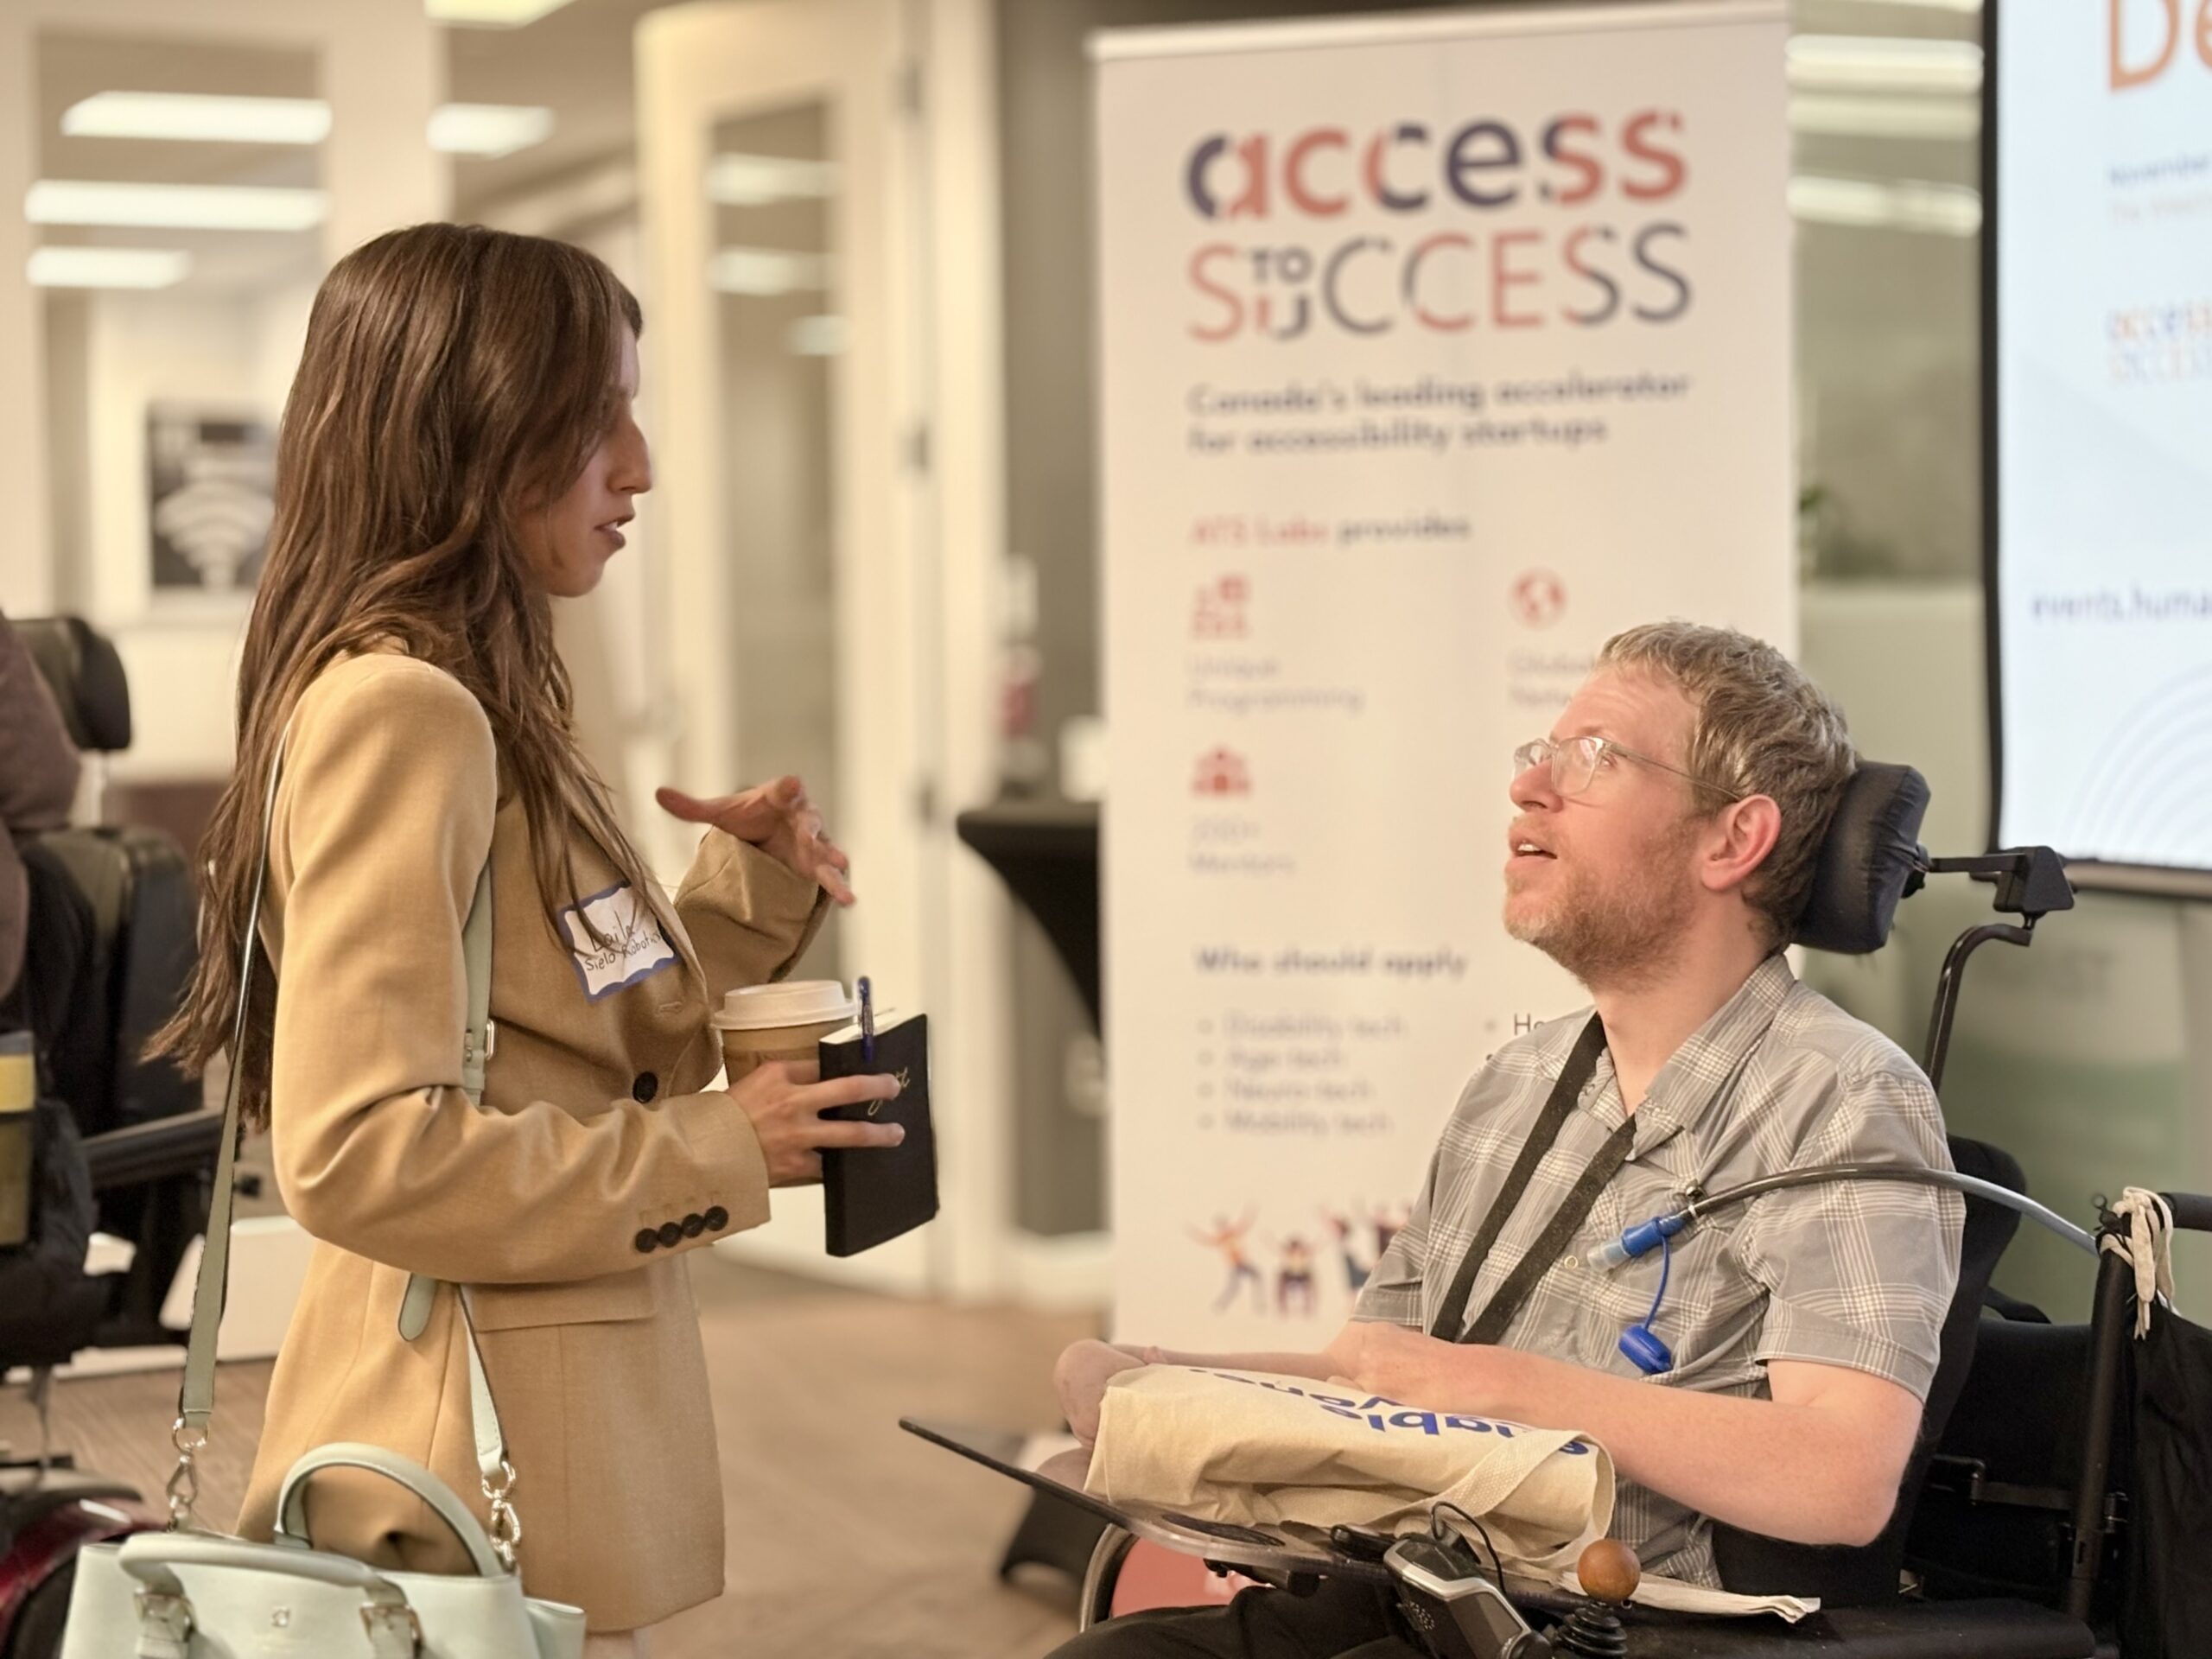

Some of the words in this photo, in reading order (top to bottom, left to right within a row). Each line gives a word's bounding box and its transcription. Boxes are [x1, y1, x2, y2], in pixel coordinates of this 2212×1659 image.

[1185, 111, 1689, 219] access
[1186, 221, 1694, 346] SUCCESS
[1187, 378, 1348, 415] Canada's
[1356, 373, 1484, 413] leading
[1497, 366, 1692, 404] accelerator
[1187, 423, 1236, 453] for
[1247, 419, 1452, 454] accessibility
